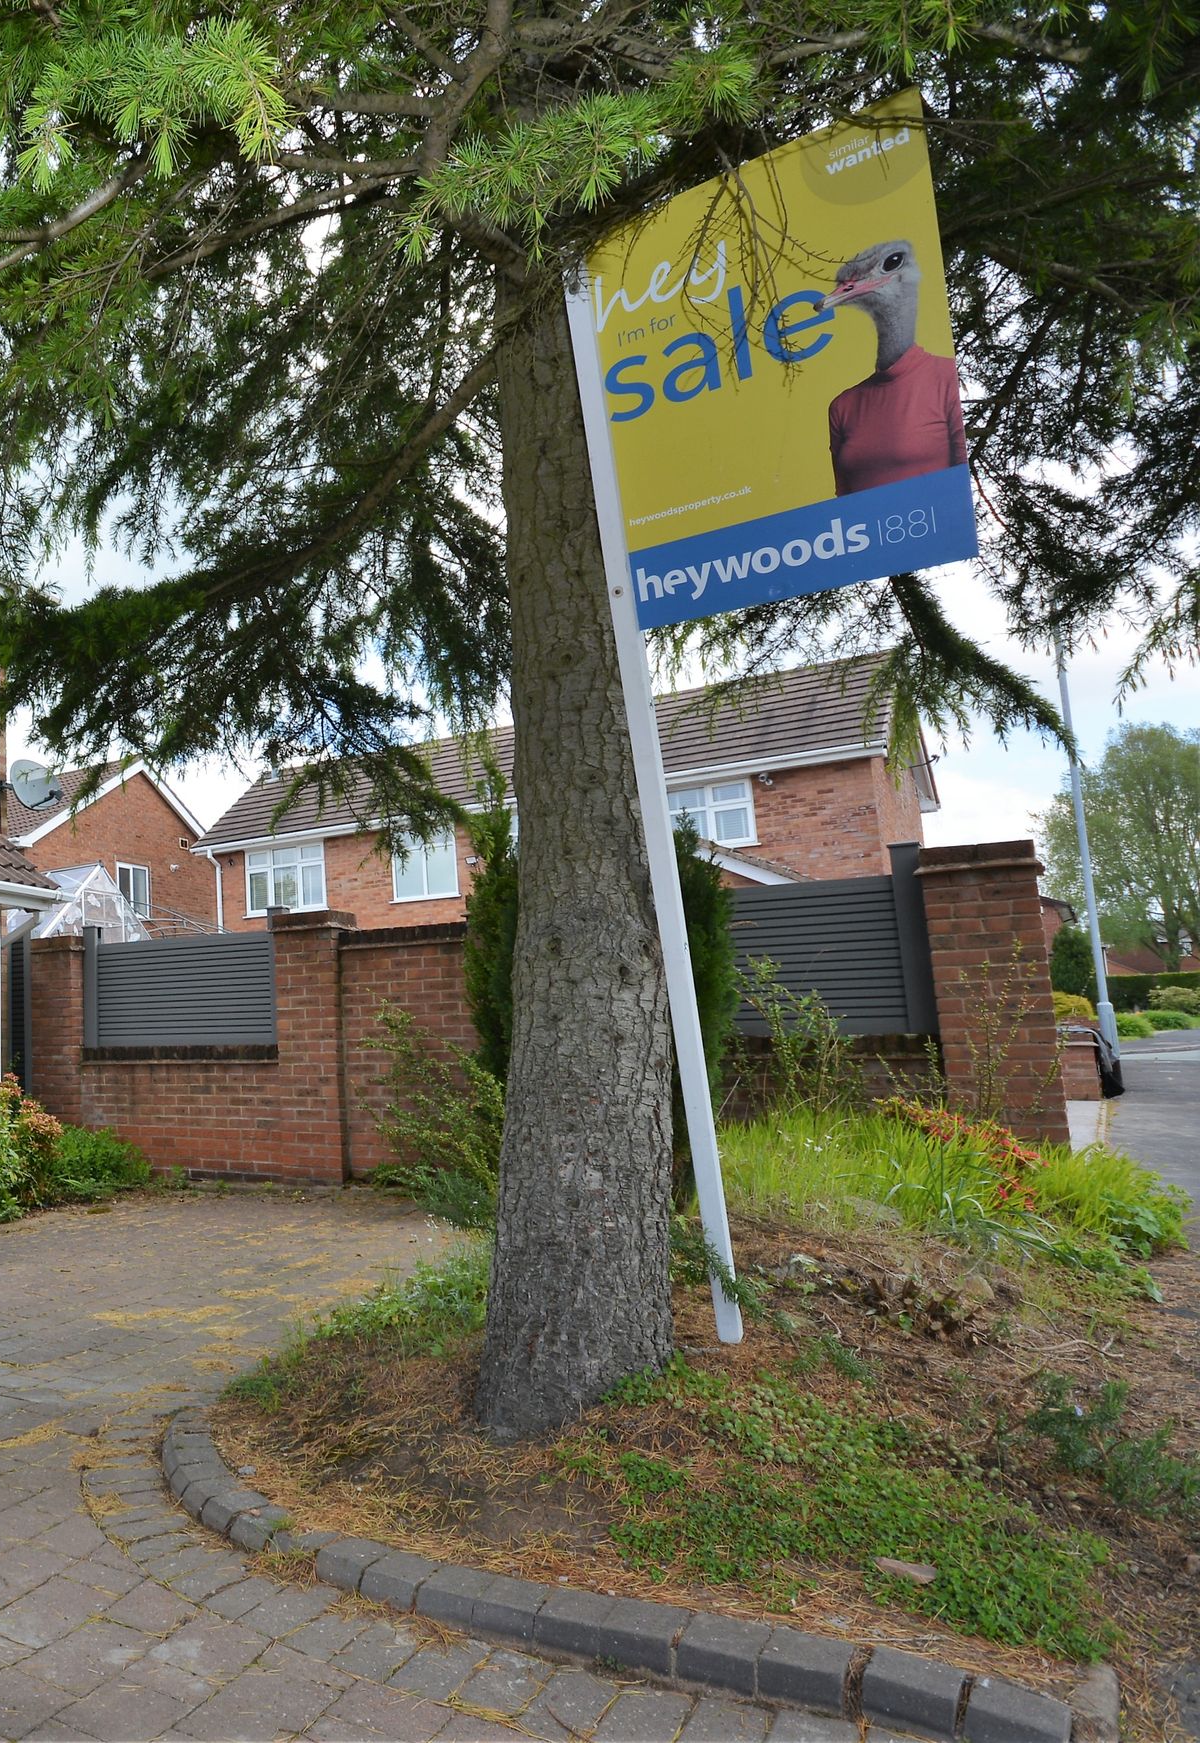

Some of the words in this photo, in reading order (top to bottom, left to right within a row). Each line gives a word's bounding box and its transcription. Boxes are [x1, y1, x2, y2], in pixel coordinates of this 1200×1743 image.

[825, 127, 910, 176] wanted
[829, 135, 869, 160] similar
[595, 240, 726, 333] hey
[605, 286, 836, 422] sale
[618, 328, 645, 347] I'm
[649, 314, 676, 334] for
[629, 486, 752, 527] heywoodsproperty.co.uk
[636, 518, 870, 602] heywoods
[877, 506, 937, 546] 1881
